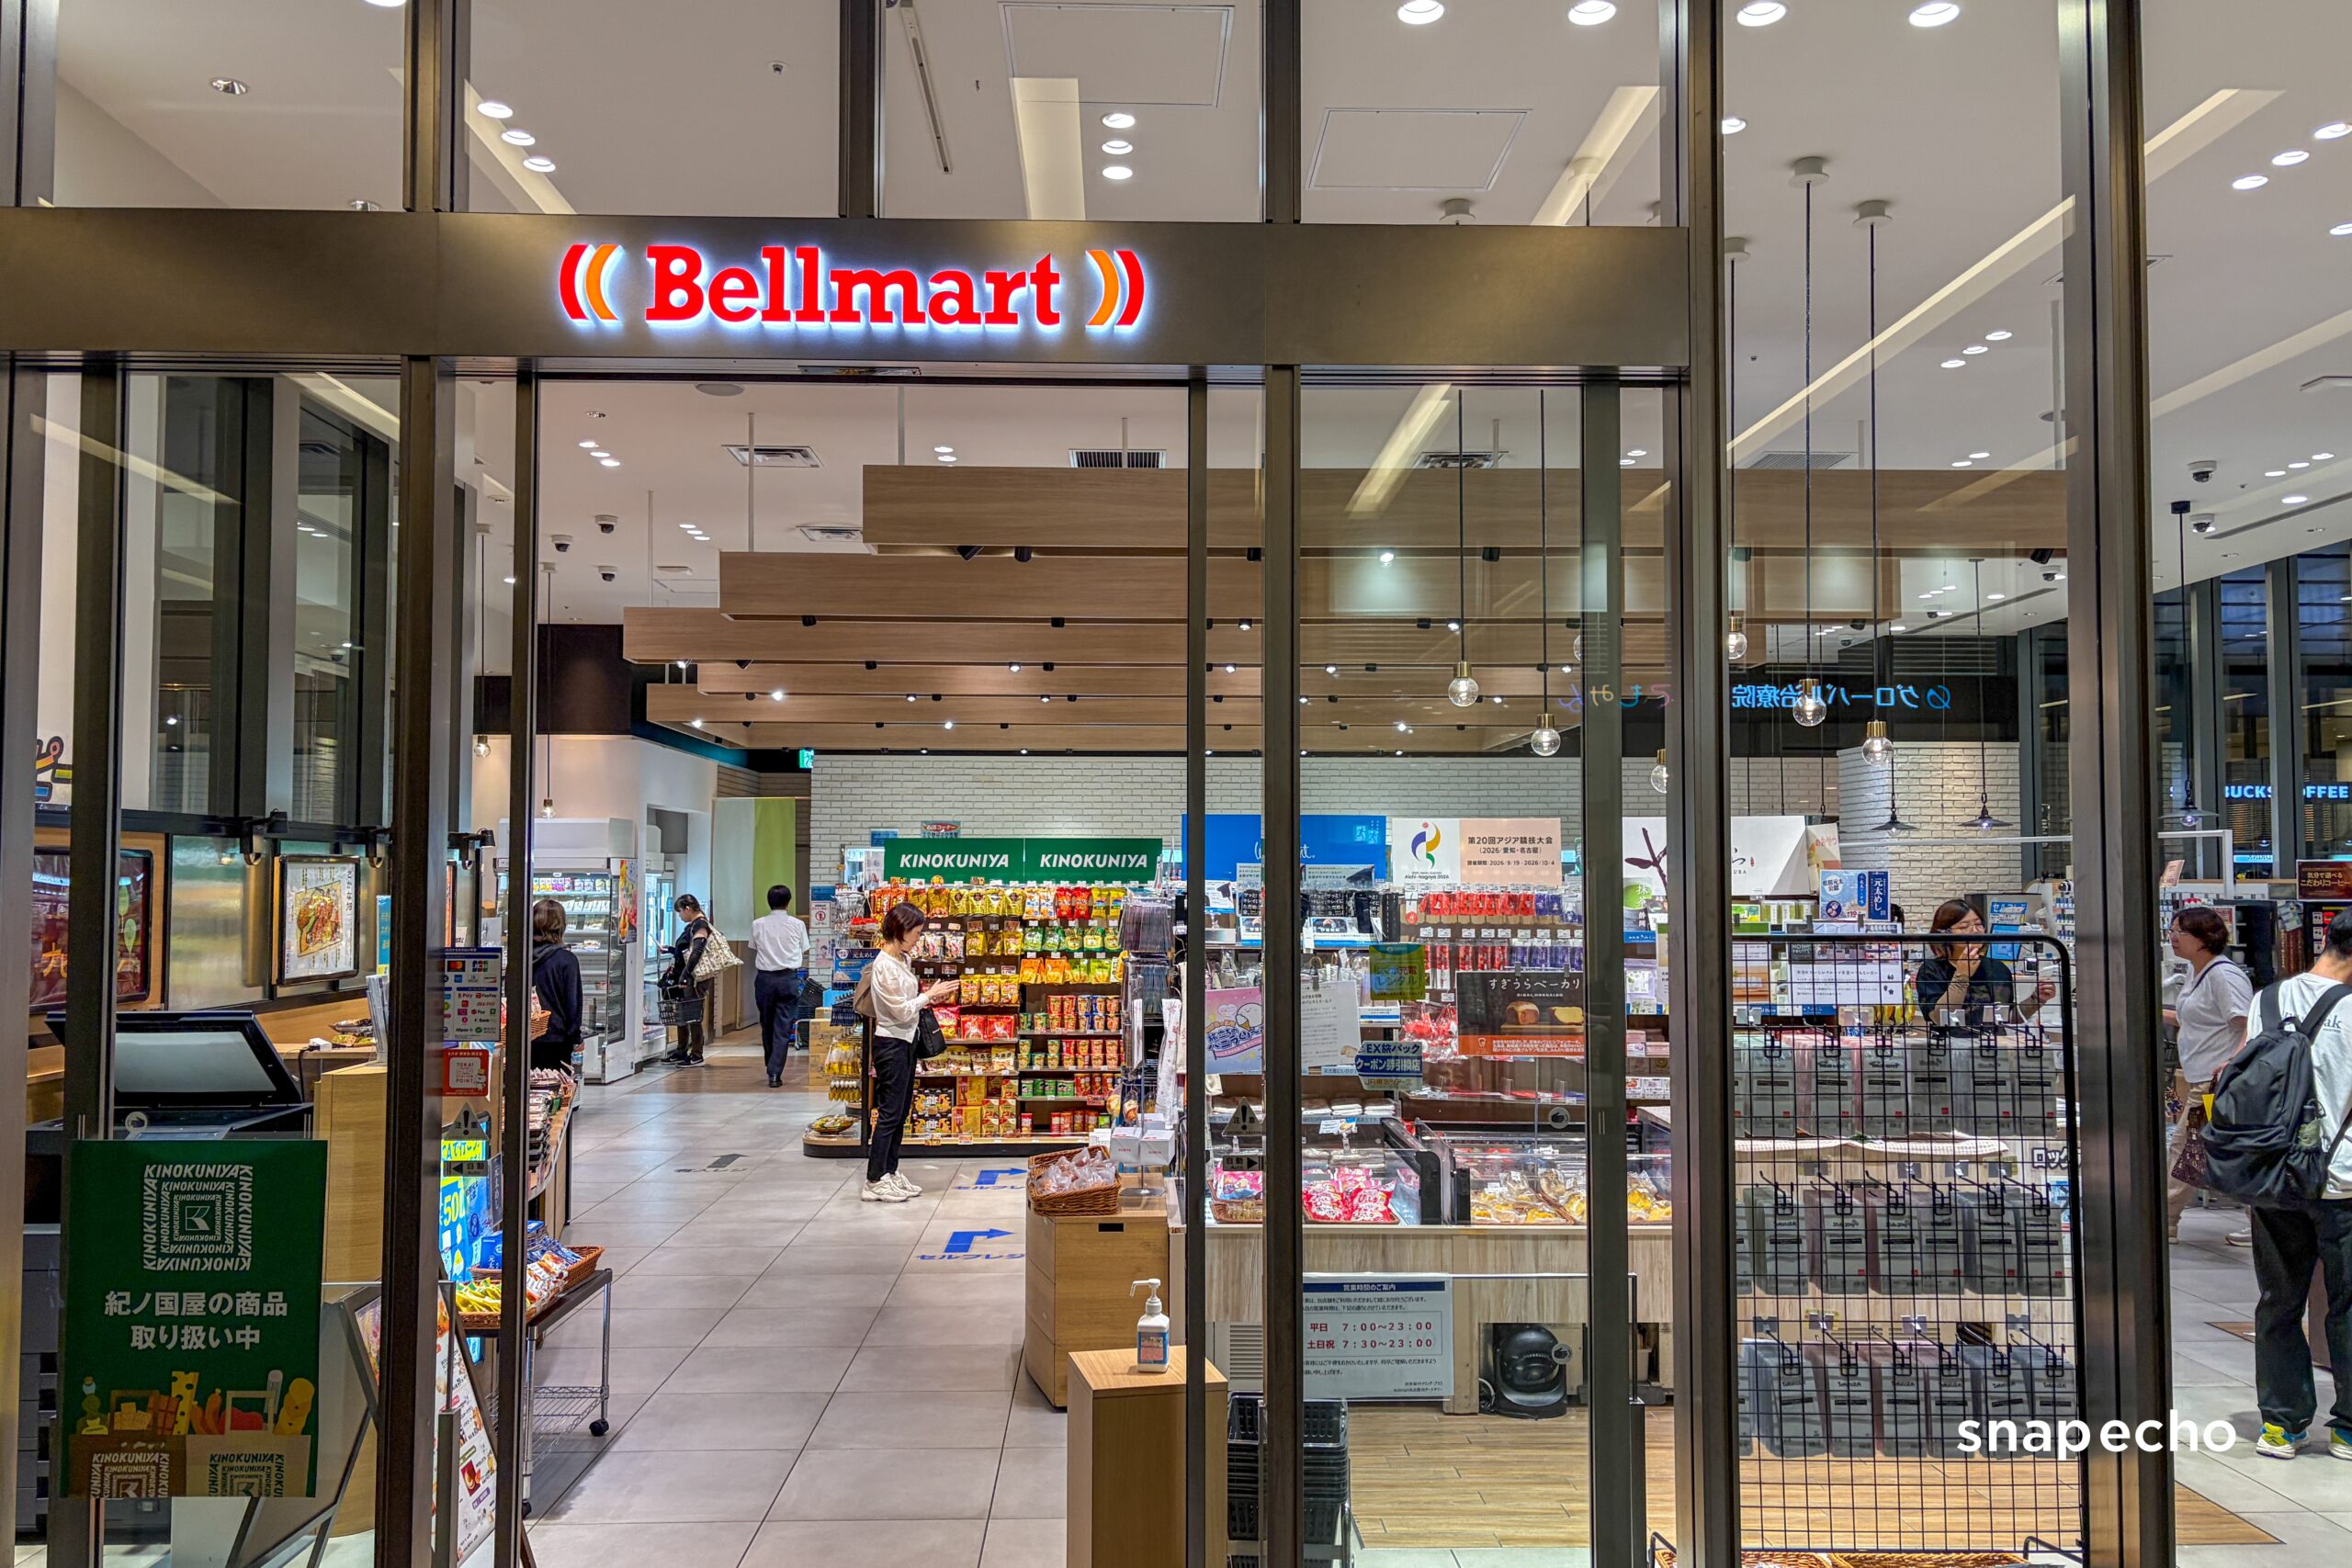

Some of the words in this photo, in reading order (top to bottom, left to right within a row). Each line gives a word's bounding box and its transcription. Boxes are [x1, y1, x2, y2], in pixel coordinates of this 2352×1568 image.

[646, 245, 1060, 325] Bellmart
[2303, 785, 2349, 798] FFEE
[1467, 836, 1553, 845] 第20回アジア競技大会
[899, 853, 1009, 869] KINOKUNIYA
[1039, 853, 1148, 869] KINOKUNIYA
[1488, 977, 1580, 990] すぎうらベーカリ
[1366, 1043, 1420, 1054] EX旅パック
[1355, 1058, 1420, 1072] クーポン券引換店
[143, 1164, 240, 1179] KINOKUNIYA
[161, 1181, 227, 1191] KINOKUNIYA
[238, 1165, 254, 1258] KINOKUNIYA
[143, 1178, 158, 1270] KINOKUNIYA
[156, 1257, 252, 1271] KINOKUNIYA
[1343, 1283, 1396, 1292] 営業時間のご案内
[105, 1291, 288, 1317] 紀ノ国屋の商品
[1309, 1323, 1329, 1333] 平日
[130, 1325, 261, 1351] 取り扱い中
[1306, 1339, 1335, 1349] 土日祝
[92, 1452, 160, 1464] KINOKUNIYA
[209, 1453, 275, 1464] KINOKUNIYA
